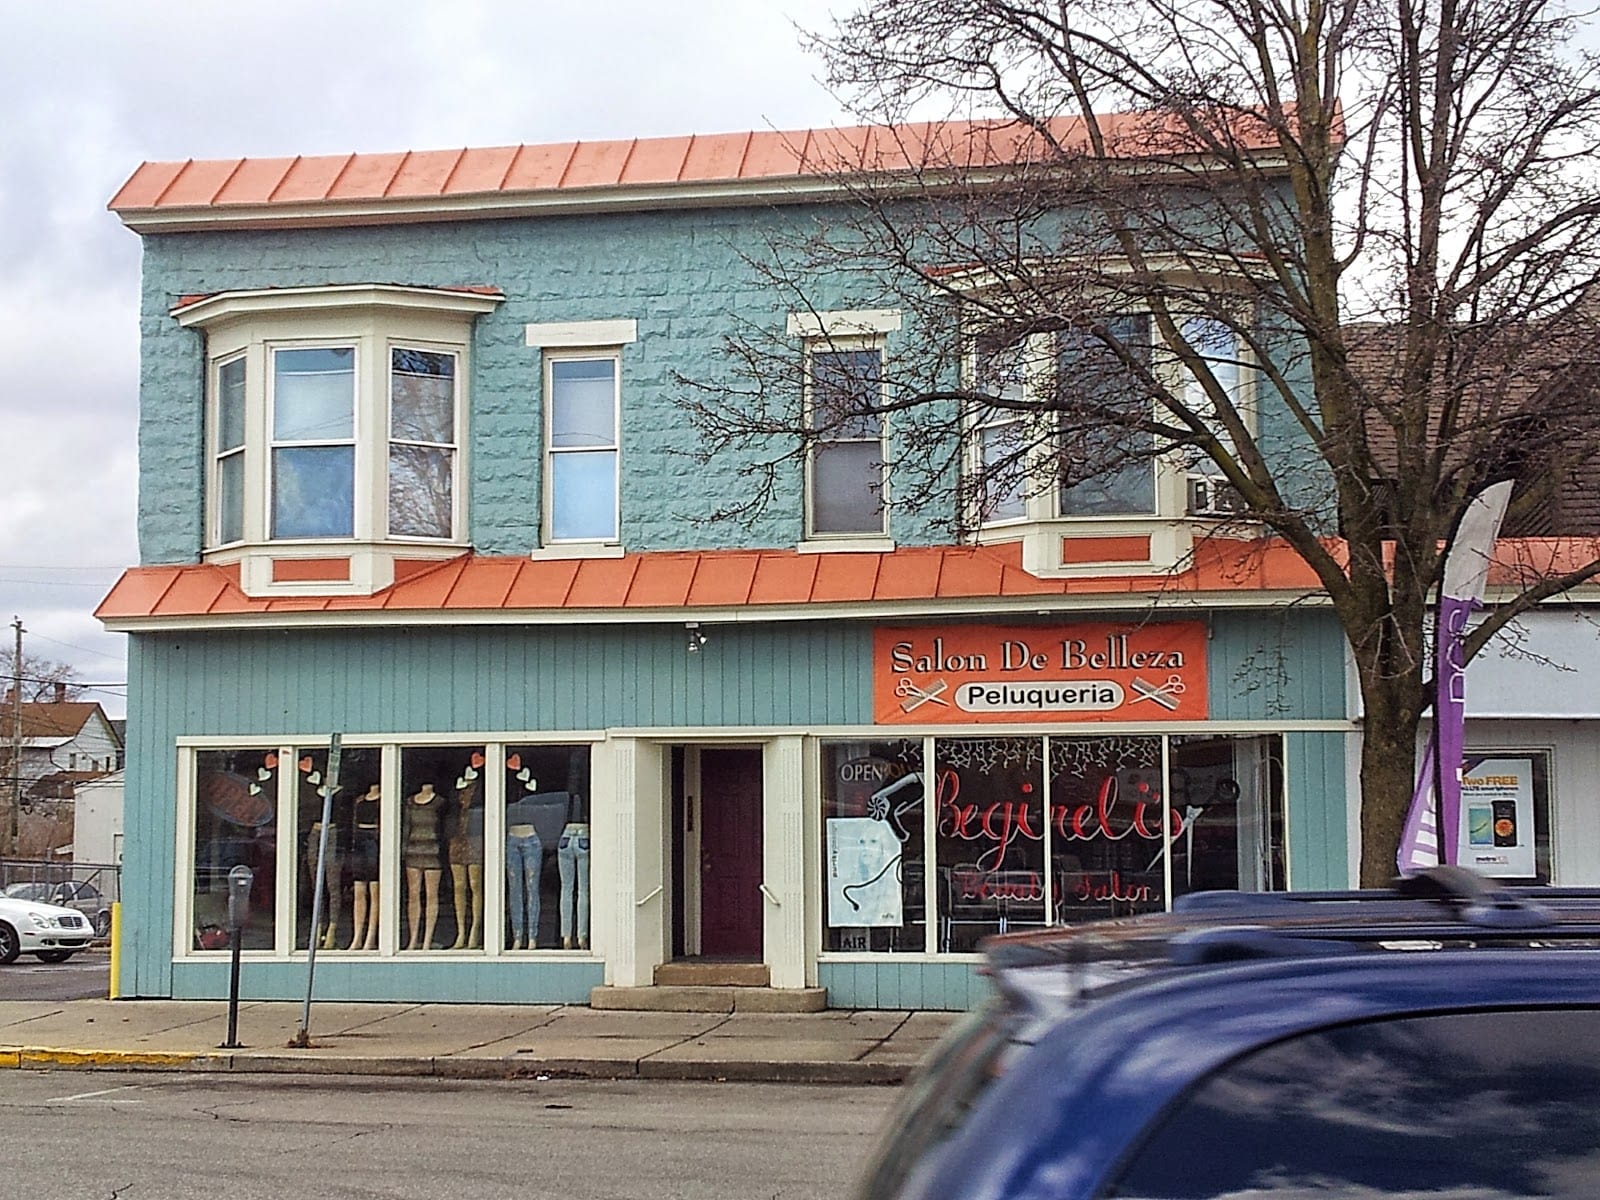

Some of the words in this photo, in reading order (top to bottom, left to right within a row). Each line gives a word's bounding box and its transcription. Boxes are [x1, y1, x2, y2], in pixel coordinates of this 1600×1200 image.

[891, 638, 987, 673] Salon
[1000, 640, 1049, 671] De
[1060, 634, 1184, 671] Belleza
[968, 684, 1115, 708] Peluqueria
[841, 764, 883, 781] OPEN
[1462, 776, 1484, 785] Two
[1486, 776, 1518, 785] FREE
